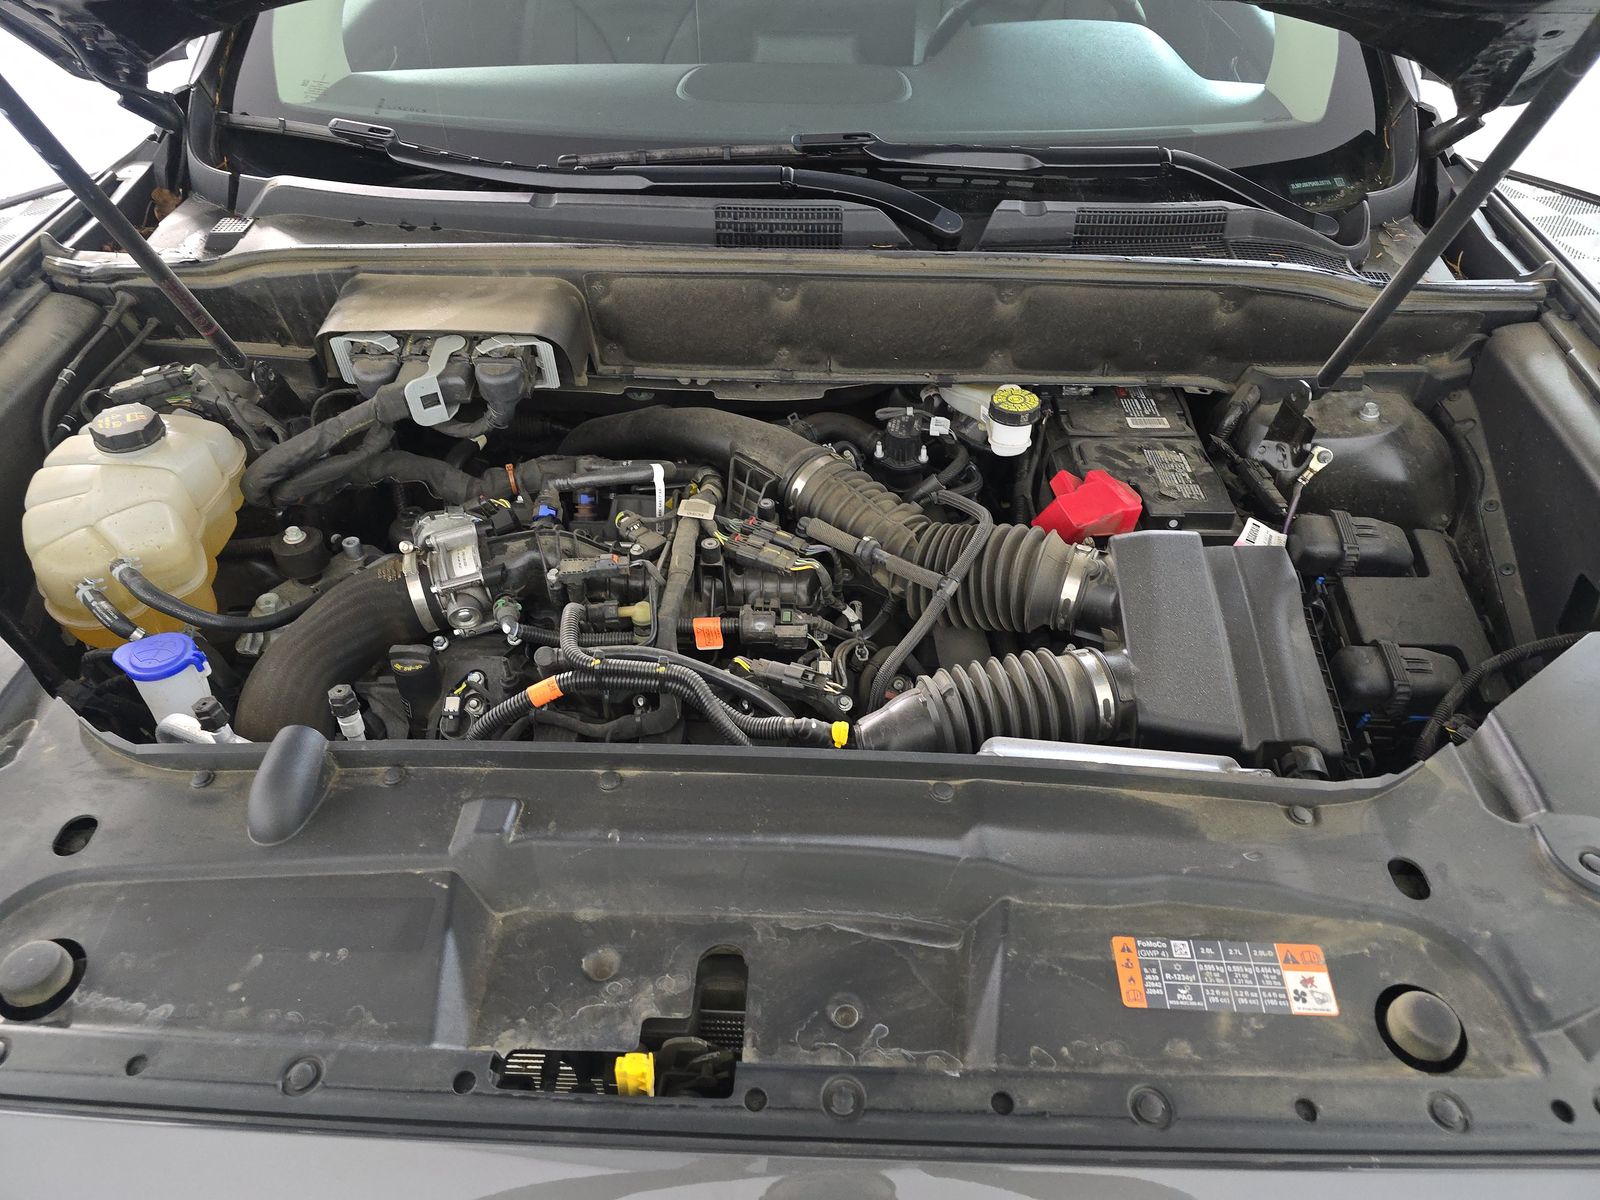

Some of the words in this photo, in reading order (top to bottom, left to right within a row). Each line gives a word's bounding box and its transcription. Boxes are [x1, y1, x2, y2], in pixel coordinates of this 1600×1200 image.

[1137, 940, 1167, 948] FoMoCo
[1138, 949, 1160, 958] (GWP
[1161, 950, 1169, 958] 4)
[1216, 965, 1225, 974] kg
[1244, 966, 1253, 975] kg
[1271, 967, 1280, 976] kg
